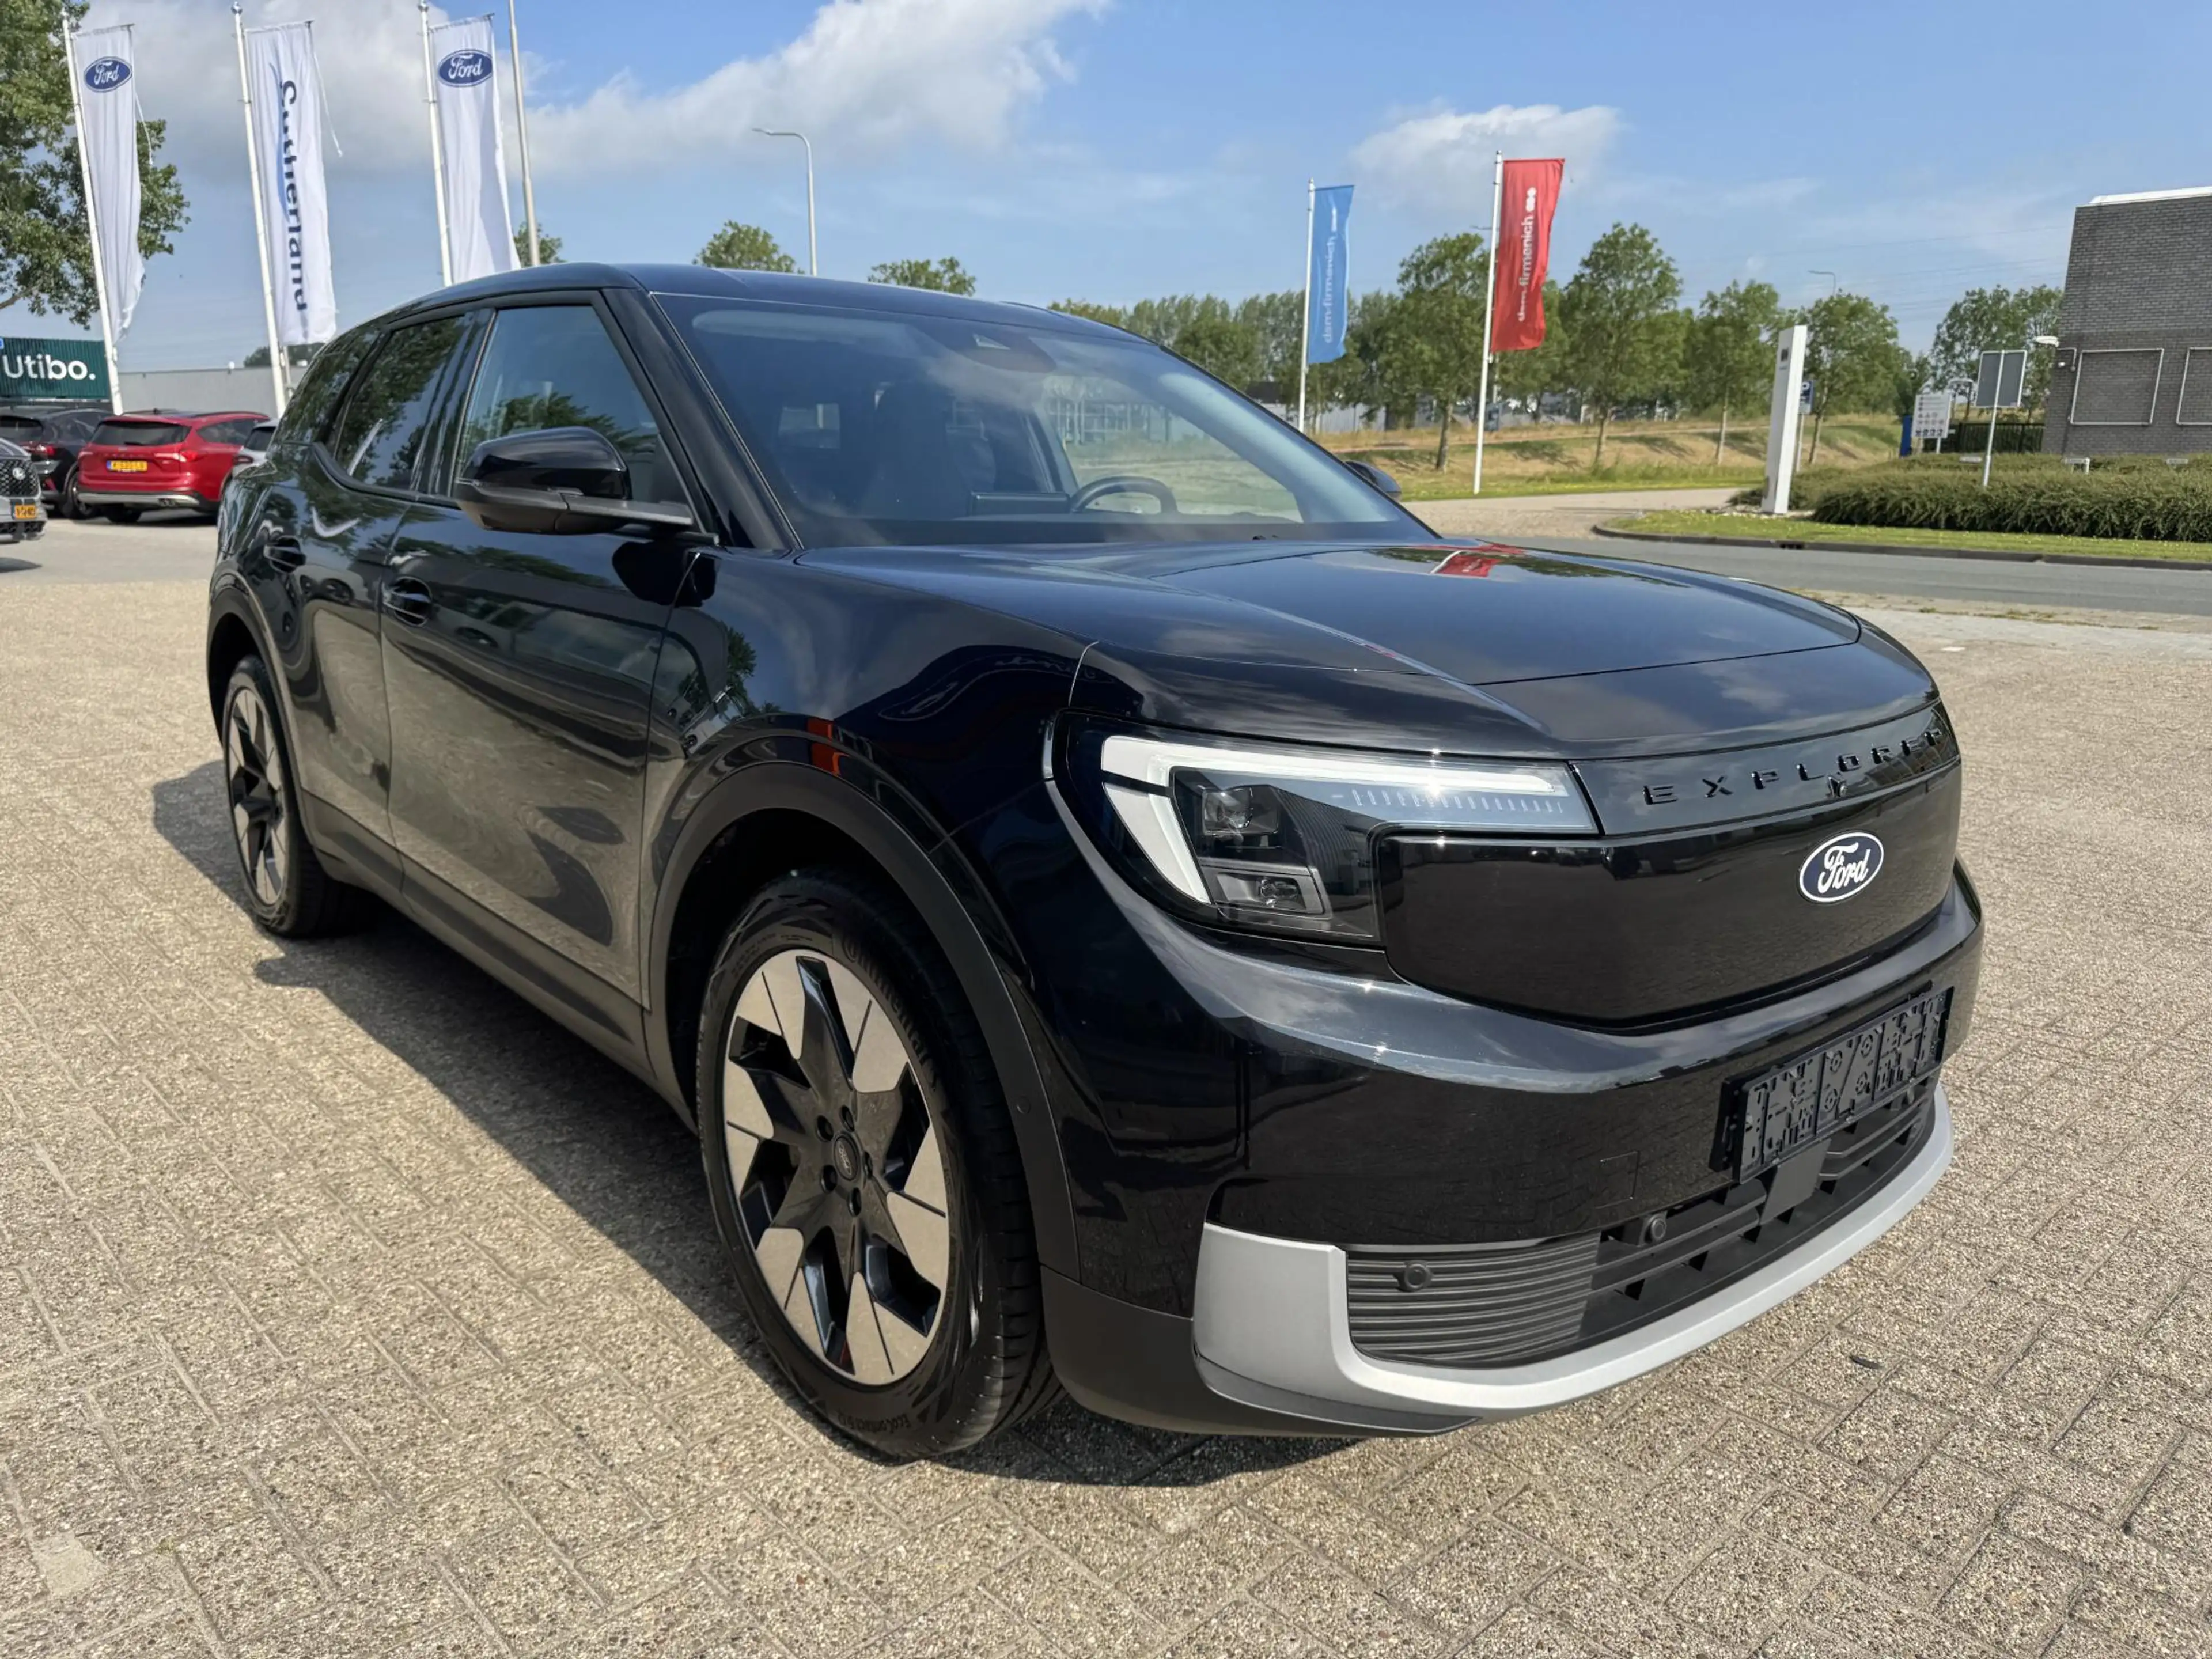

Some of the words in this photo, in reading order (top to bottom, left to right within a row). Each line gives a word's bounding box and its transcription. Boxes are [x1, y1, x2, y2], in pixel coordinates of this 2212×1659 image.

[94, 62, 119, 85] Ford
[448, 54, 484, 79] Ford
[2, 354, 96, 380] Utibo.
[1643, 729, 1945, 806] EXPLORER
[1817, 841, 1870, 894] Ford
